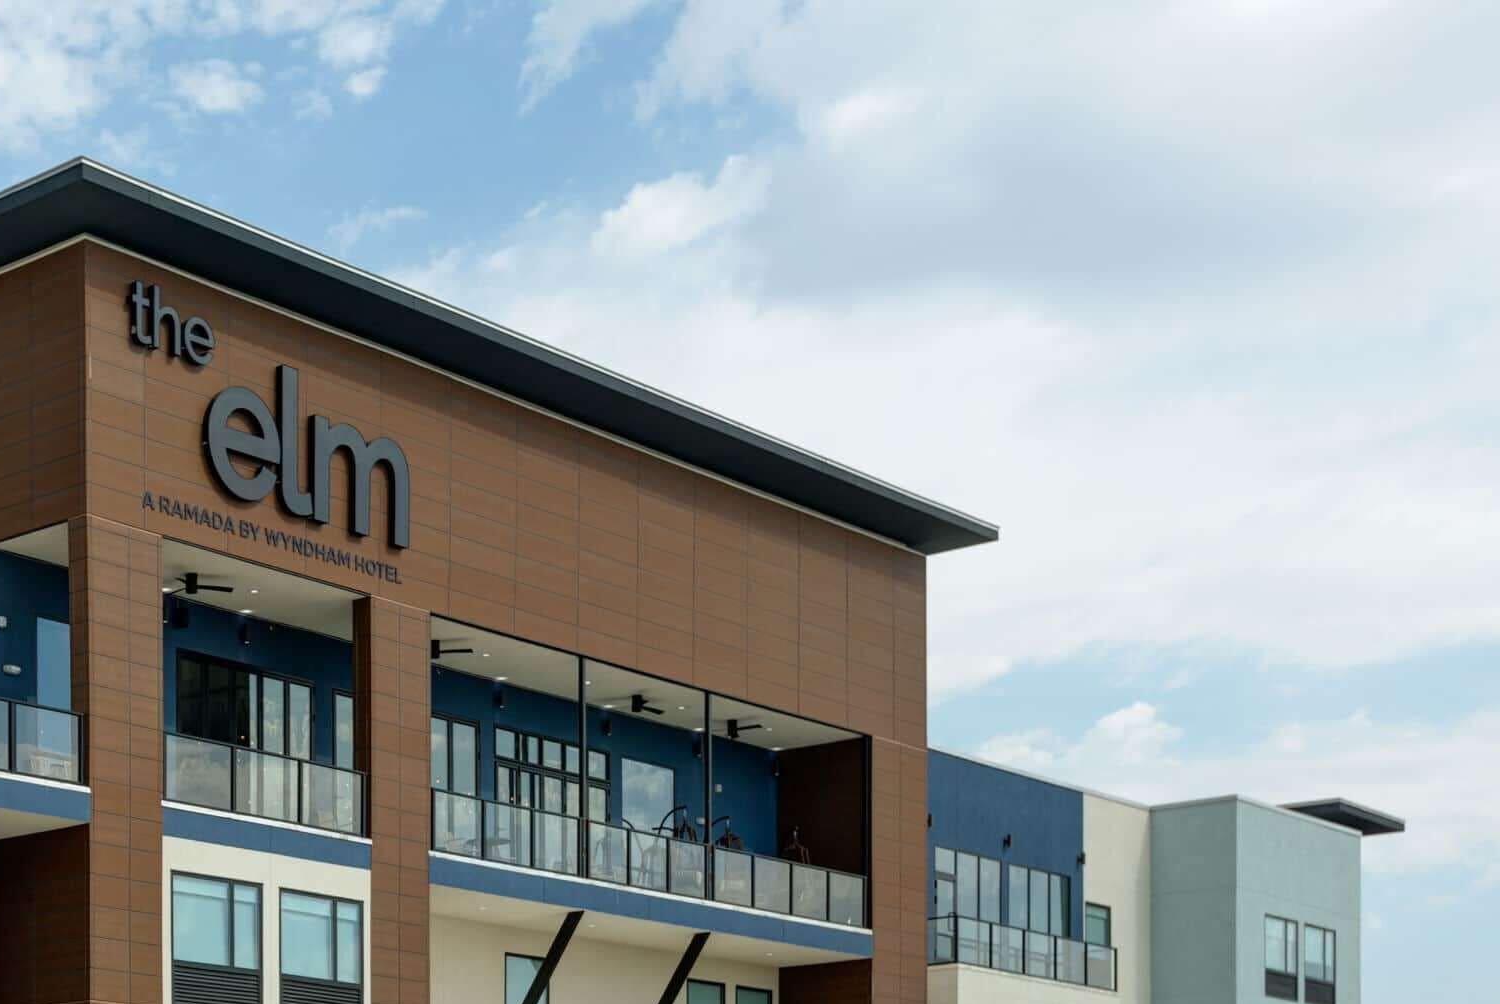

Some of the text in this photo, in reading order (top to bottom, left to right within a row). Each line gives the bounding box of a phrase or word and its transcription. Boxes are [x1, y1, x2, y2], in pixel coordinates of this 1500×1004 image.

[129, 280, 215, 367] the
[204, 364, 411, 550] elm
[142, 491, 402, 585] A RAMADA BY WYNDHAM HOTEL
